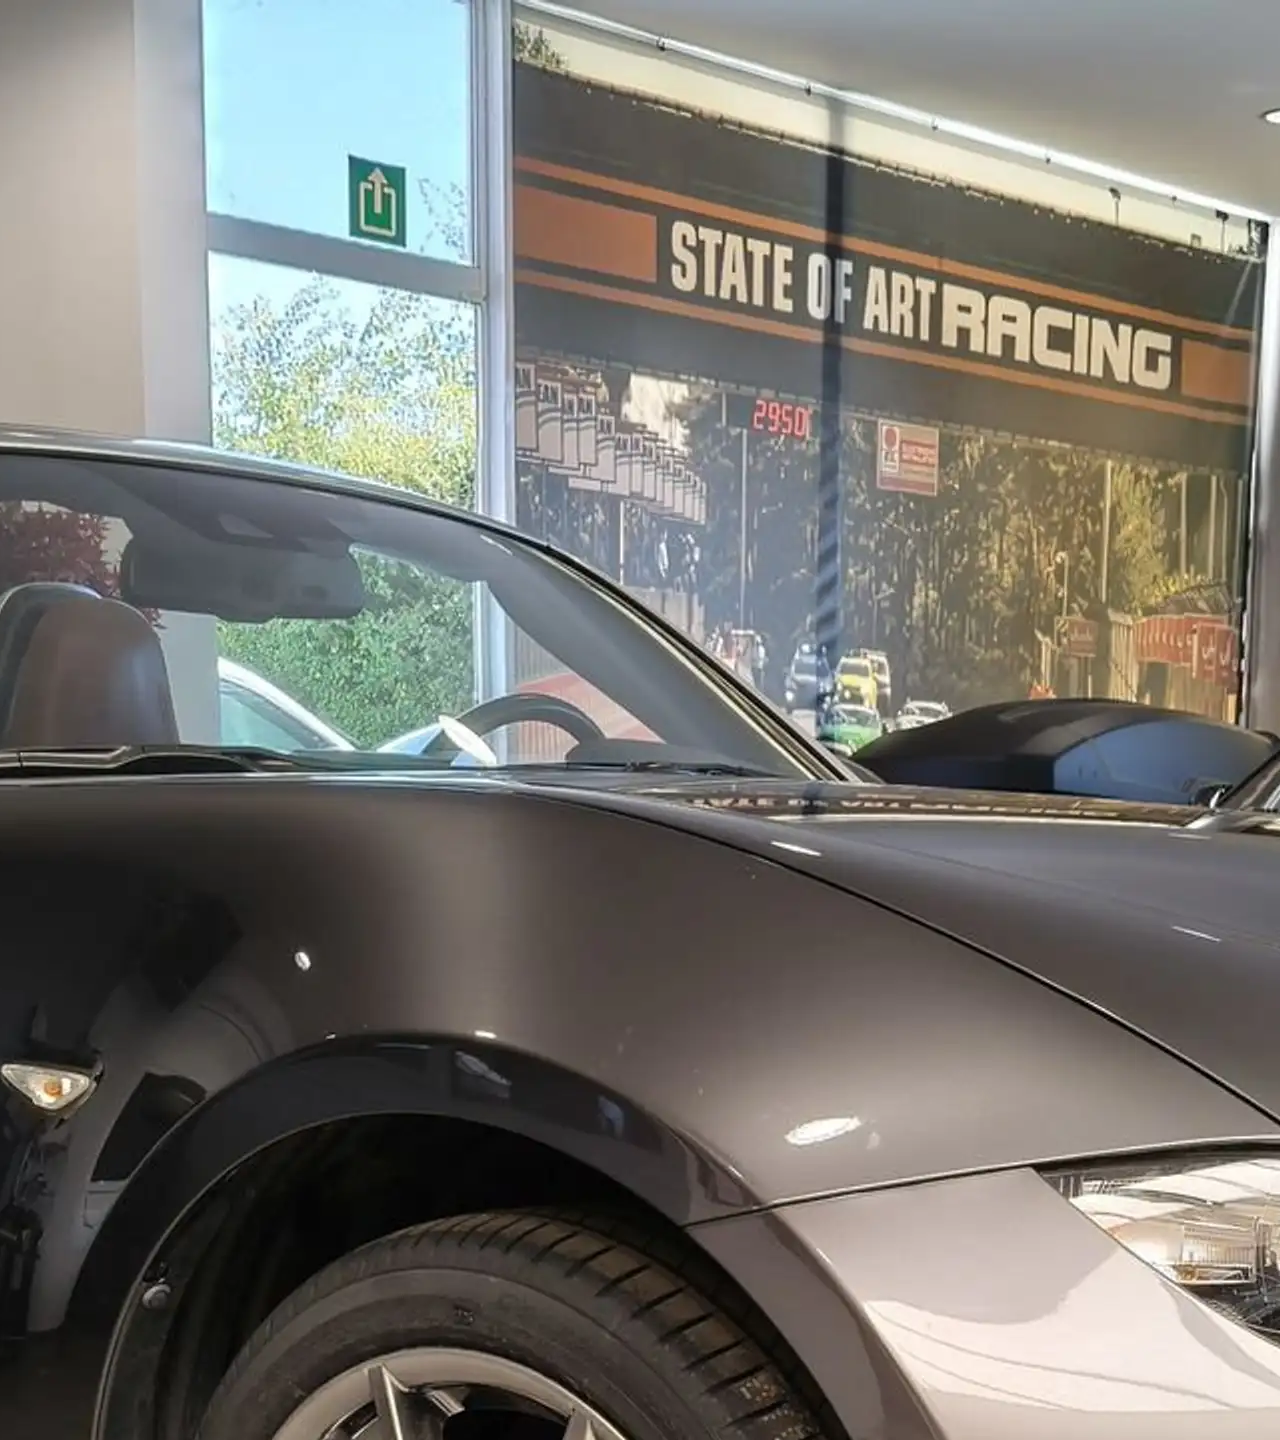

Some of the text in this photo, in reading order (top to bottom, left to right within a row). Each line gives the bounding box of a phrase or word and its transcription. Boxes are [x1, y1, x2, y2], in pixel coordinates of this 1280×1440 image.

[670, 220, 1173, 391] STATE OF ART RACING
